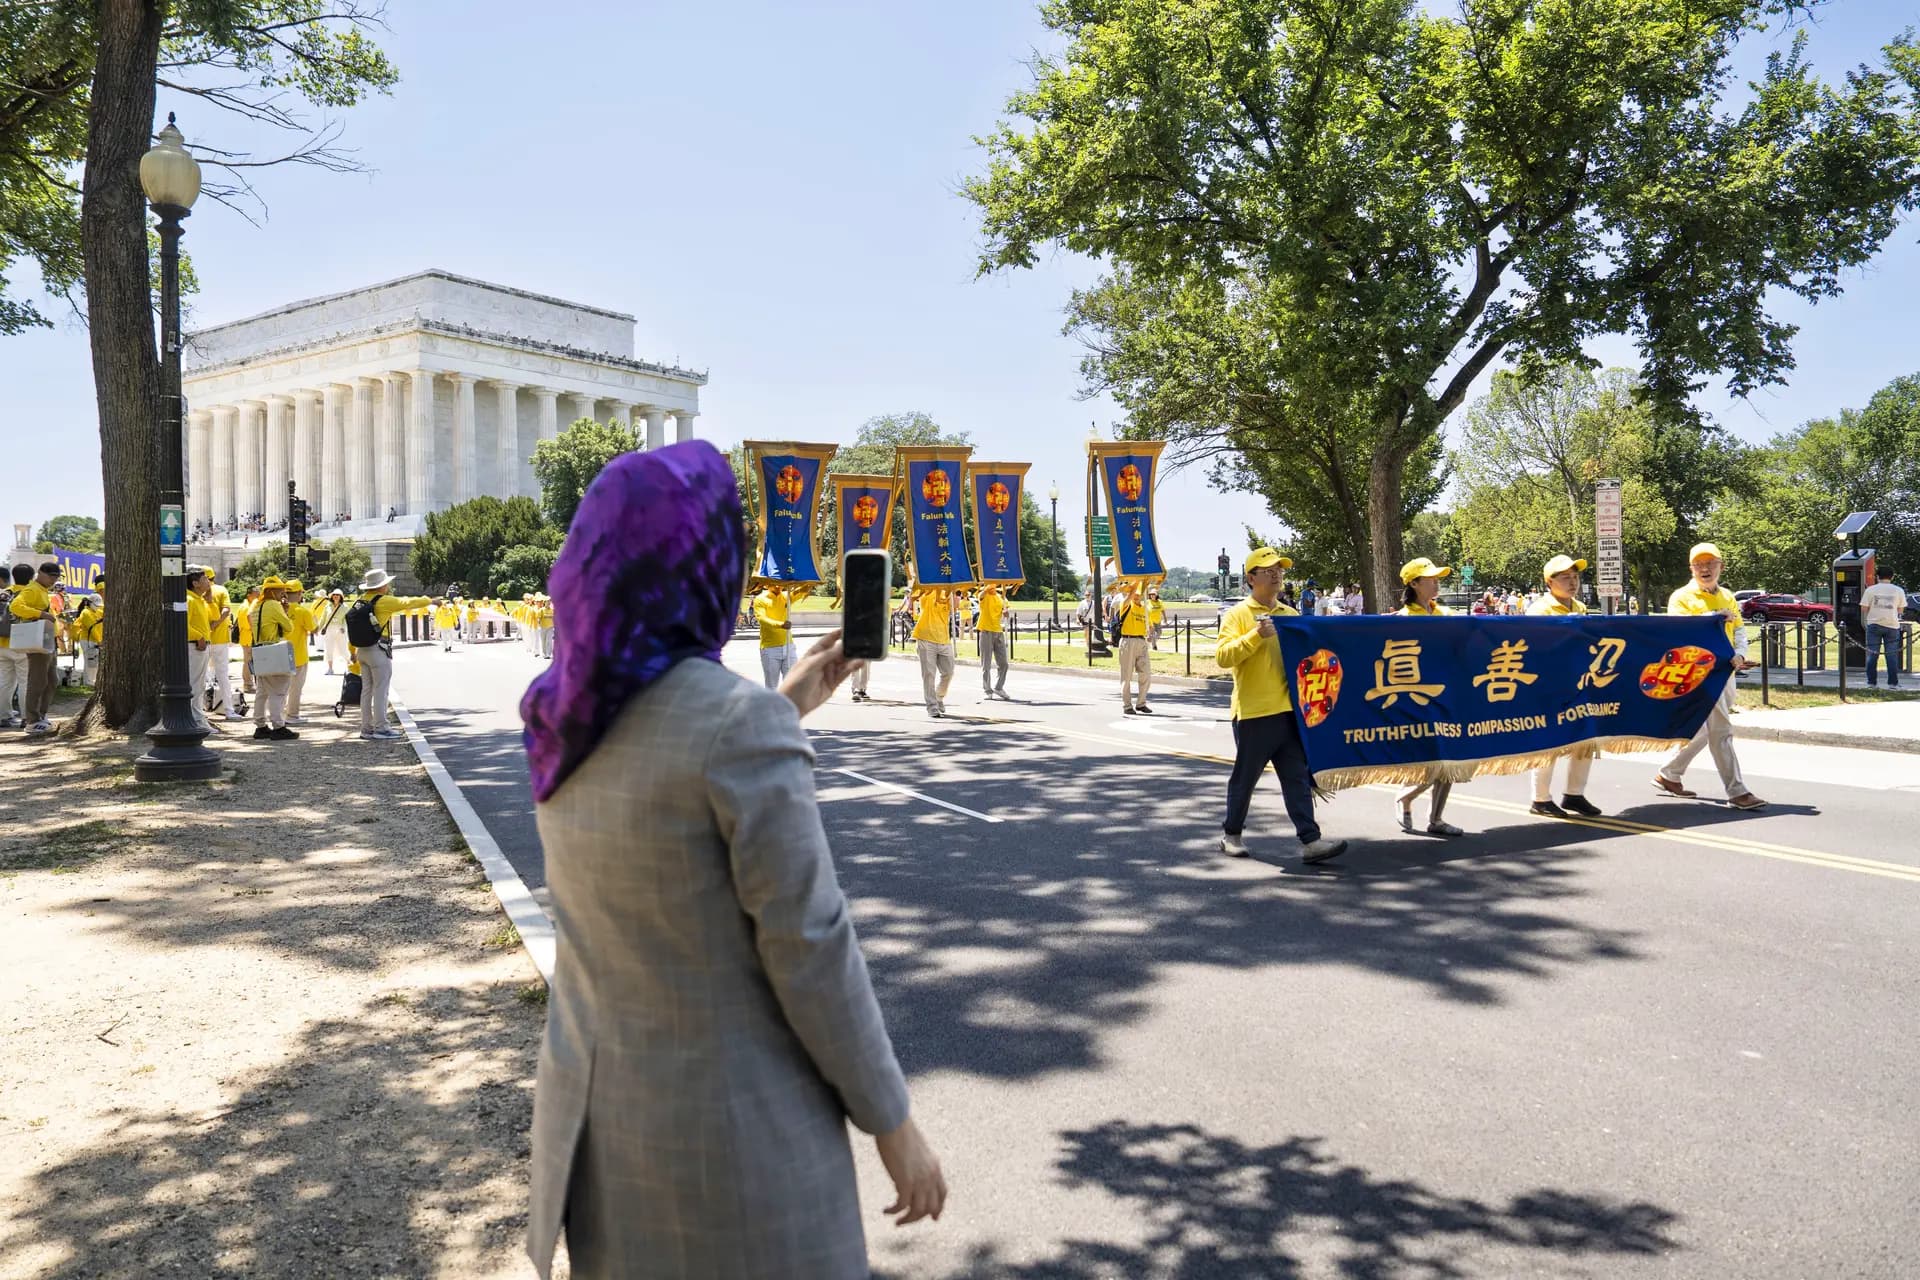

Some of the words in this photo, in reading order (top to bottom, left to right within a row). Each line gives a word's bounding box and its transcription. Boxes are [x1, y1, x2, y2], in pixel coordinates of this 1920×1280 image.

[1472, 638, 1539, 703] 善
[1343, 721, 1462, 744] TRUTHFULNESS
[1467, 714, 1547, 738] COMPASSION
